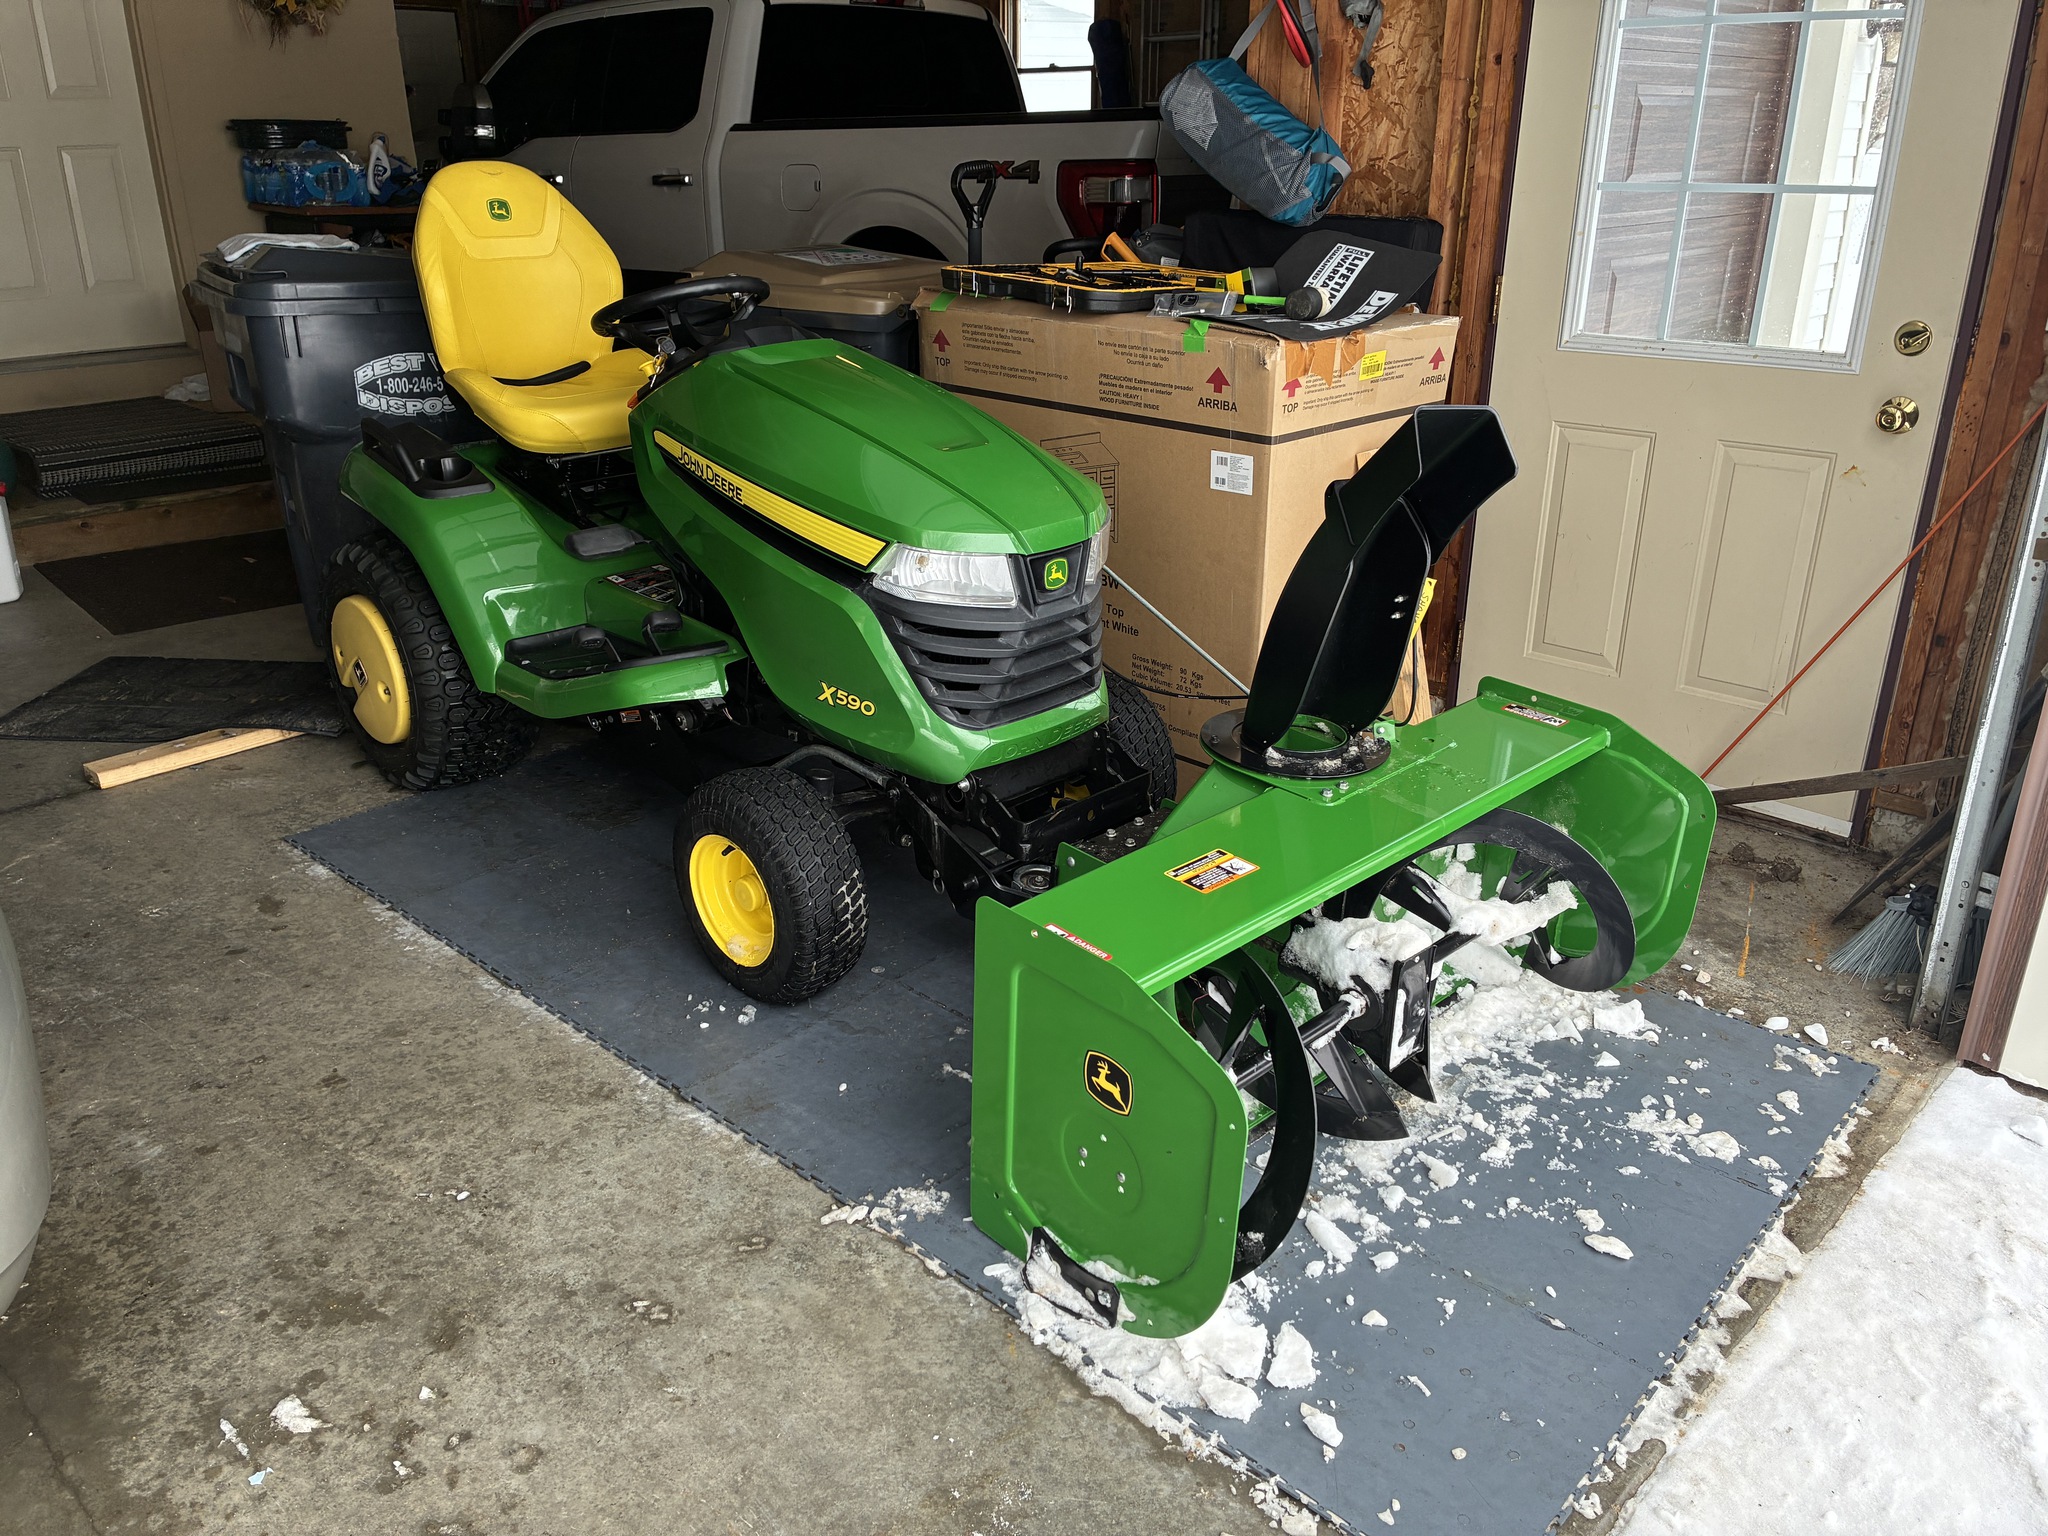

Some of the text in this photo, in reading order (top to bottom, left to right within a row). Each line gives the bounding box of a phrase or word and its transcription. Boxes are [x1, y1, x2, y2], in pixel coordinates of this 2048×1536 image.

[977, 160, 1040, 184] x4
[1312, 245, 1343, 281] GUARANTEED
[1320, 254, 1352, 288] WARRA
[1327, 255, 1364, 305] LIFETIM
[935, 356, 951, 366] TOP
[1167, 349, 1186, 357] superior
[354, 352, 425, 387] BEST
[964, 366, 979, 374] Damage
[1046, 371, 1062, 380] pointing
[376, 376, 444, 394] 1-800-246-5
[1099, 380, 1118, 388] Muebles
[1125, 384, 1143, 392] madera
[1134, 377, 1174, 389] Extremadamente
[1419, 374, 1446, 387] ARRIBA
[357, 389, 457, 416] DISPOS
[1099, 389, 1122, 397] CAUTION:
[1123, 392, 1139, 400] HEAVY
[1115, 398, 1142, 409] FURNITURE
[1143, 403, 1160, 411] INSIDE
[1198, 397, 1238, 412] ARRIBA
[1282, 402, 1299, 414] TOP
[678, 446, 743, 502] JOHN DEERE
[1106, 603, 1124, 619] Top
[1112, 620, 1139, 636] White
[1132, 654, 1203, 680] Gross Weight: 90 Kgs
[1132, 662, 1202, 689] Net Weight: 72 Kgs
[1132, 670, 1148, 680] Cubic
[1150, 676, 1173, 688] Volume:
[1176, 684, 1192, 693] 20.53
[816, 680, 877, 717] X590
[1168, 724, 1199, 740] Compliant
[1073, 938, 1108, 959] DANGER
